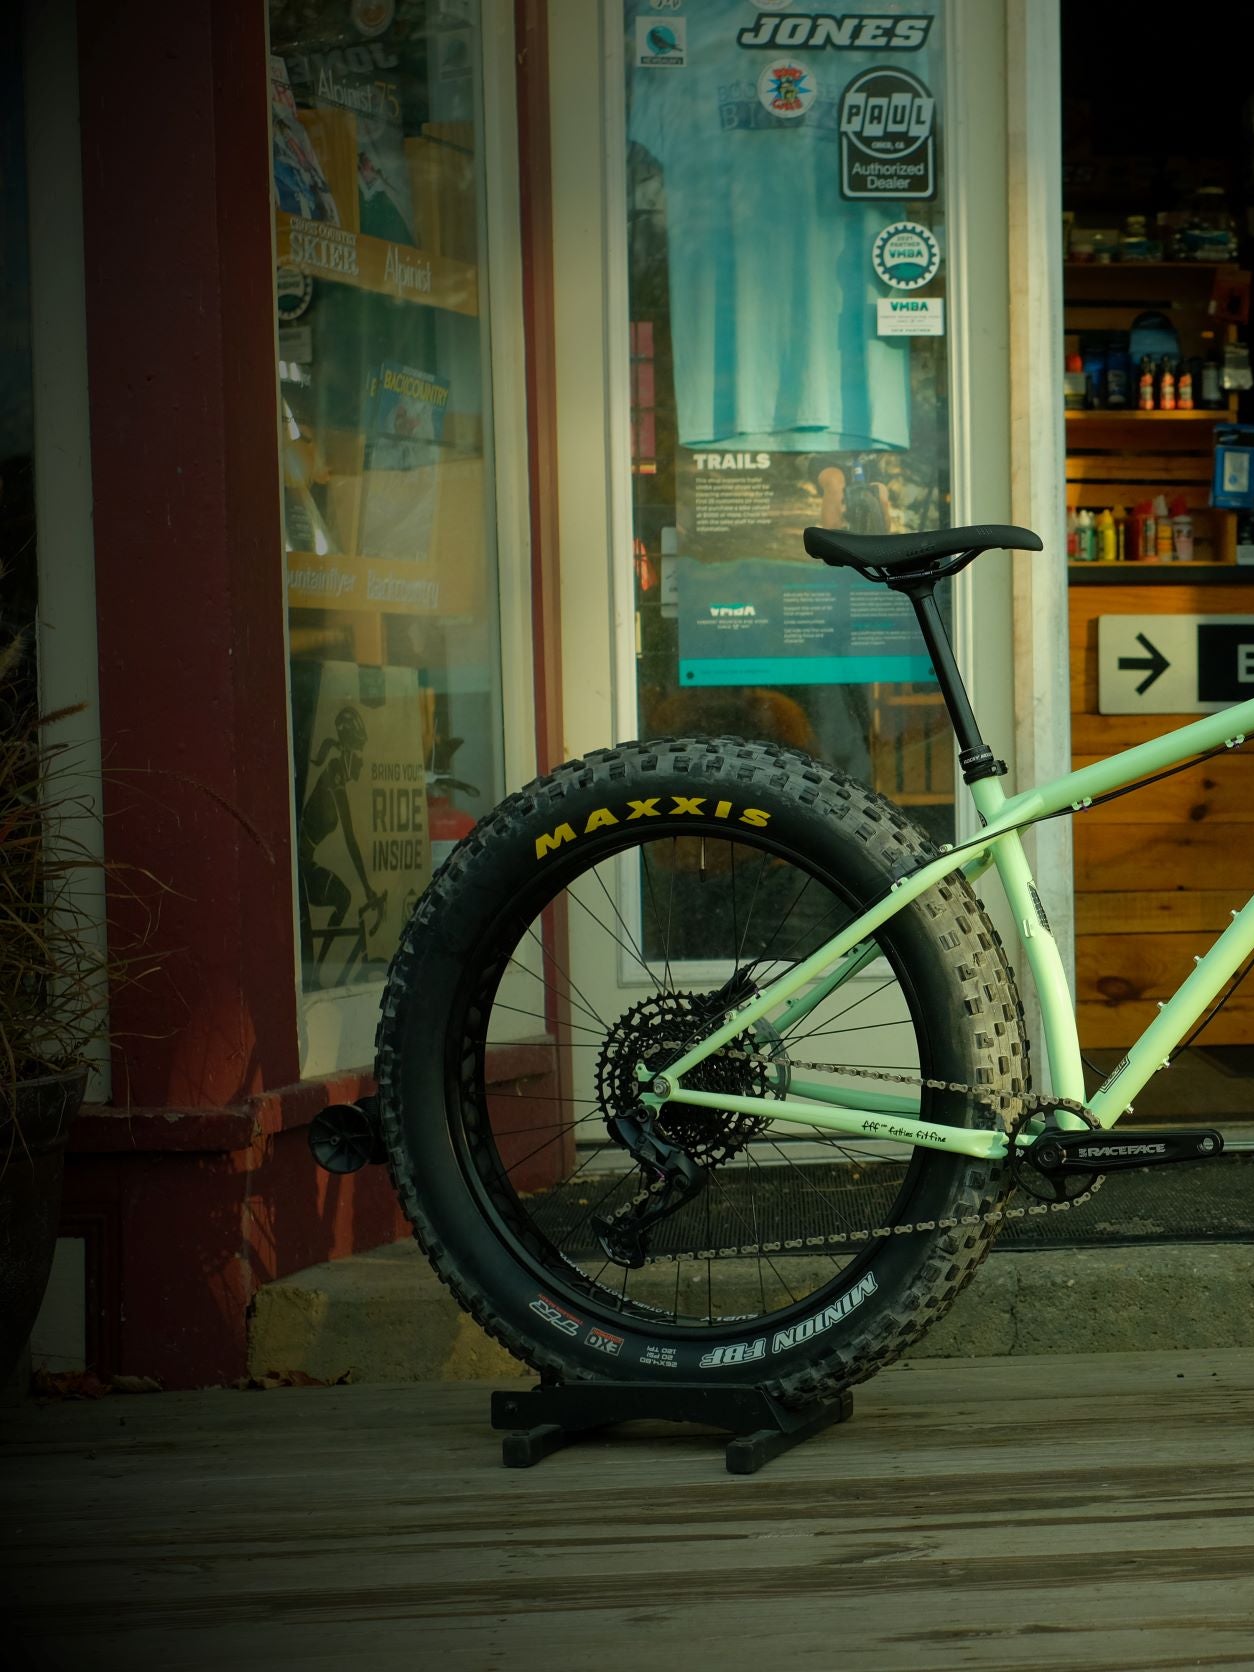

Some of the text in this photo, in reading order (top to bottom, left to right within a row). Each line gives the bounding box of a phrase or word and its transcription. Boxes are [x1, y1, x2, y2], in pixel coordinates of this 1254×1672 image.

[738, 16, 930, 48] JONES
[318, 68, 400, 118] Alpinist 75
[846, 104, 927, 125] PAUL
[852, 162, 924, 175] Authorized
[867, 176, 911, 189] Dealer
[318, 224, 357, 246] COUNTRY
[889, 249, 923, 258] VMBA
[384, 243, 432, 297] Alpinist
[890, 302, 928, 311] VMBA
[693, 453, 770, 470] TRAILS
[371, 763, 424, 781] BRING YOUR
[371, 788, 424, 833] RIDE
[535, 796, 772, 861] MAXXIS
[371, 839, 423, 873] INSIDE
[929, 1129, 947, 1143] fine
[1088, 1143, 1166, 1158] RACEFACE
[700, 1271, 878, 1368] MINION FBF
